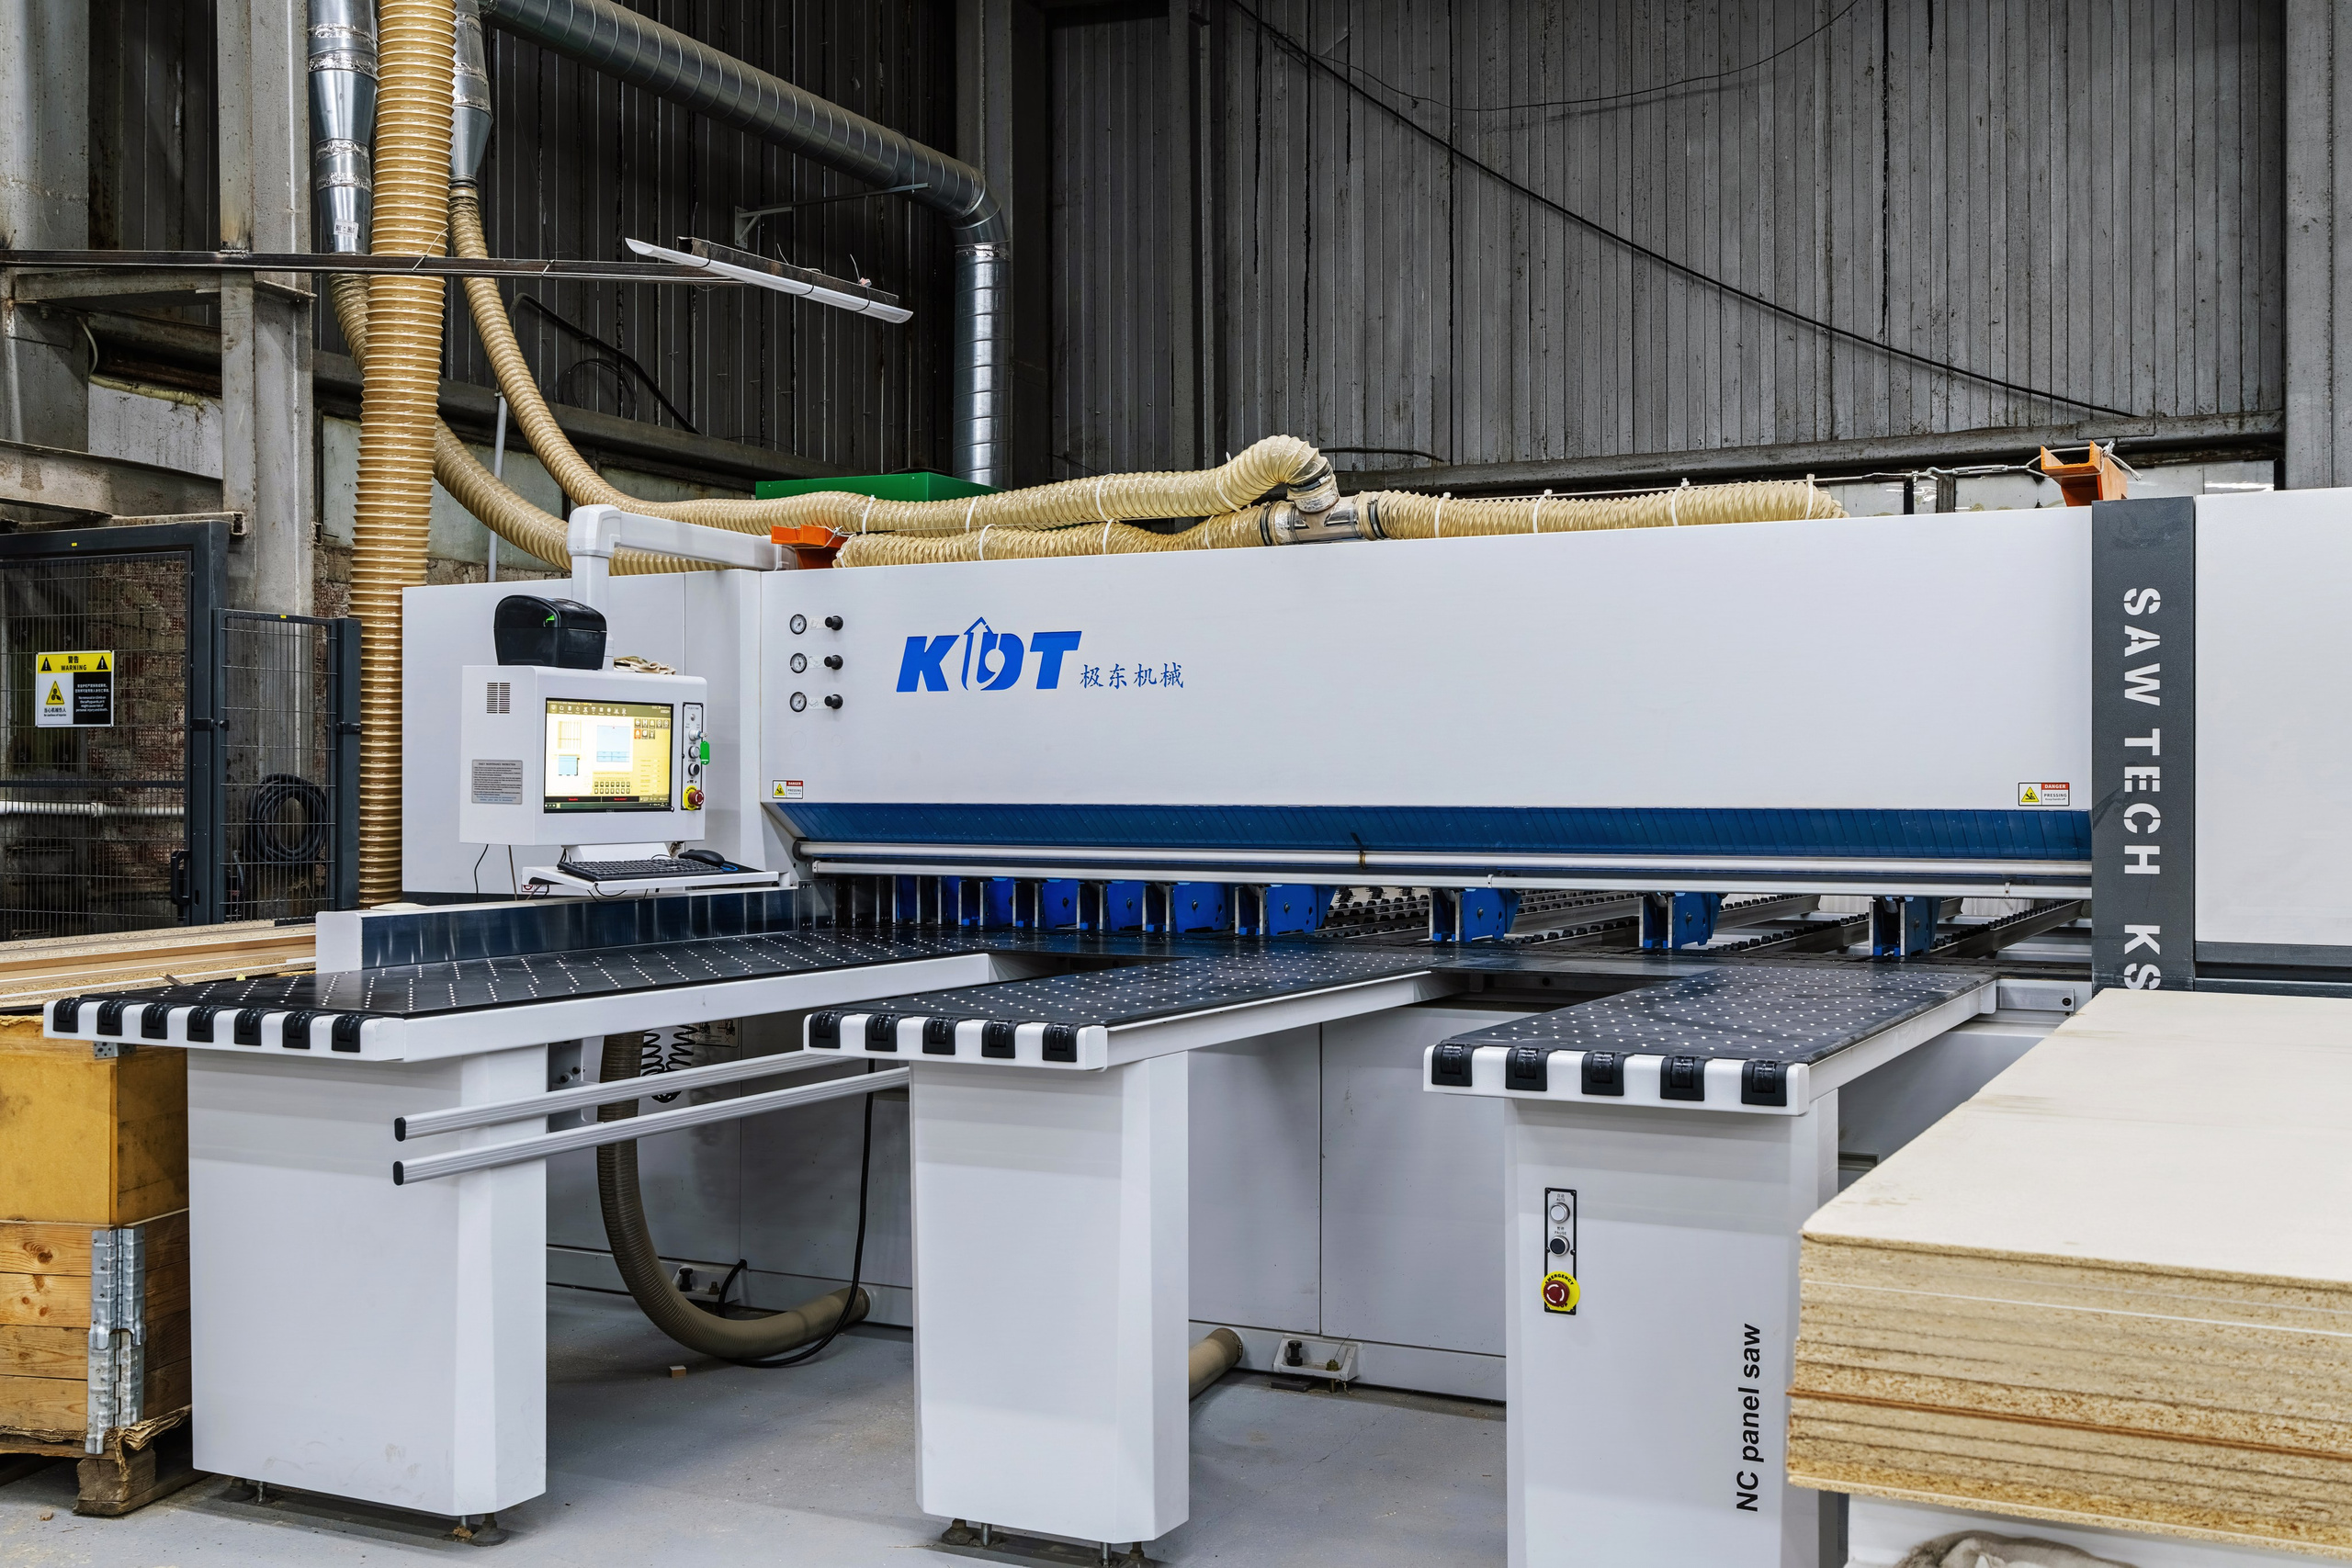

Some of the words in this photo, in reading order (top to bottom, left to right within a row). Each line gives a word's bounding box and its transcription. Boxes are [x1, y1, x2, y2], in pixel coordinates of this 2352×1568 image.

[896, 617, 1082, 693] KDT
[1080, 661, 1184, 689] 极东机械
[2123, 588, 2161, 706] SAW
[2123, 728, 2161, 874] TECH
[2124, 925, 2161, 990] KS
[1744, 1324, 1760, 1379] saw
[1738, 1387, 1764, 1462] panel
[1736, 1471, 1758, 1512] NC
